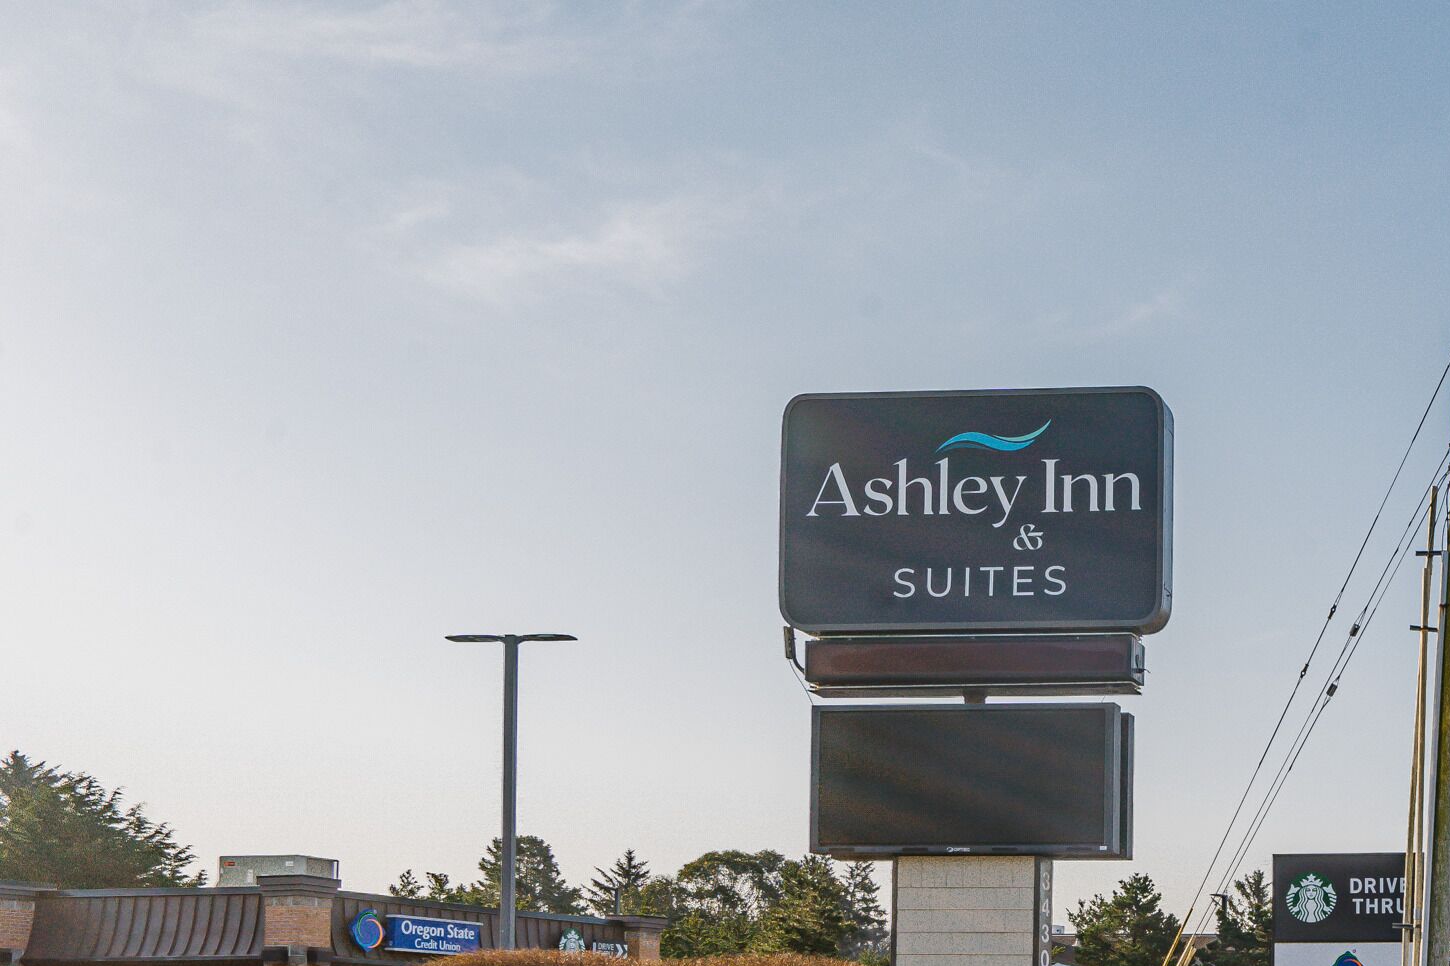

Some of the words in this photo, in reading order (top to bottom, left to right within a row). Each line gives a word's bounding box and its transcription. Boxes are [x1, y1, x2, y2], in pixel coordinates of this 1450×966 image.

[805, 457, 1027, 528] Ashley
[1041, 458, 1142, 513] Inn
[1013, 523, 1044, 551] &
[893, 565, 1067, 598] SUITES
[401, 920, 445, 939] Oregon
[447, 924, 475, 940] State
[415, 938, 438, 950] Credit
[439, 940, 461, 952] Union
